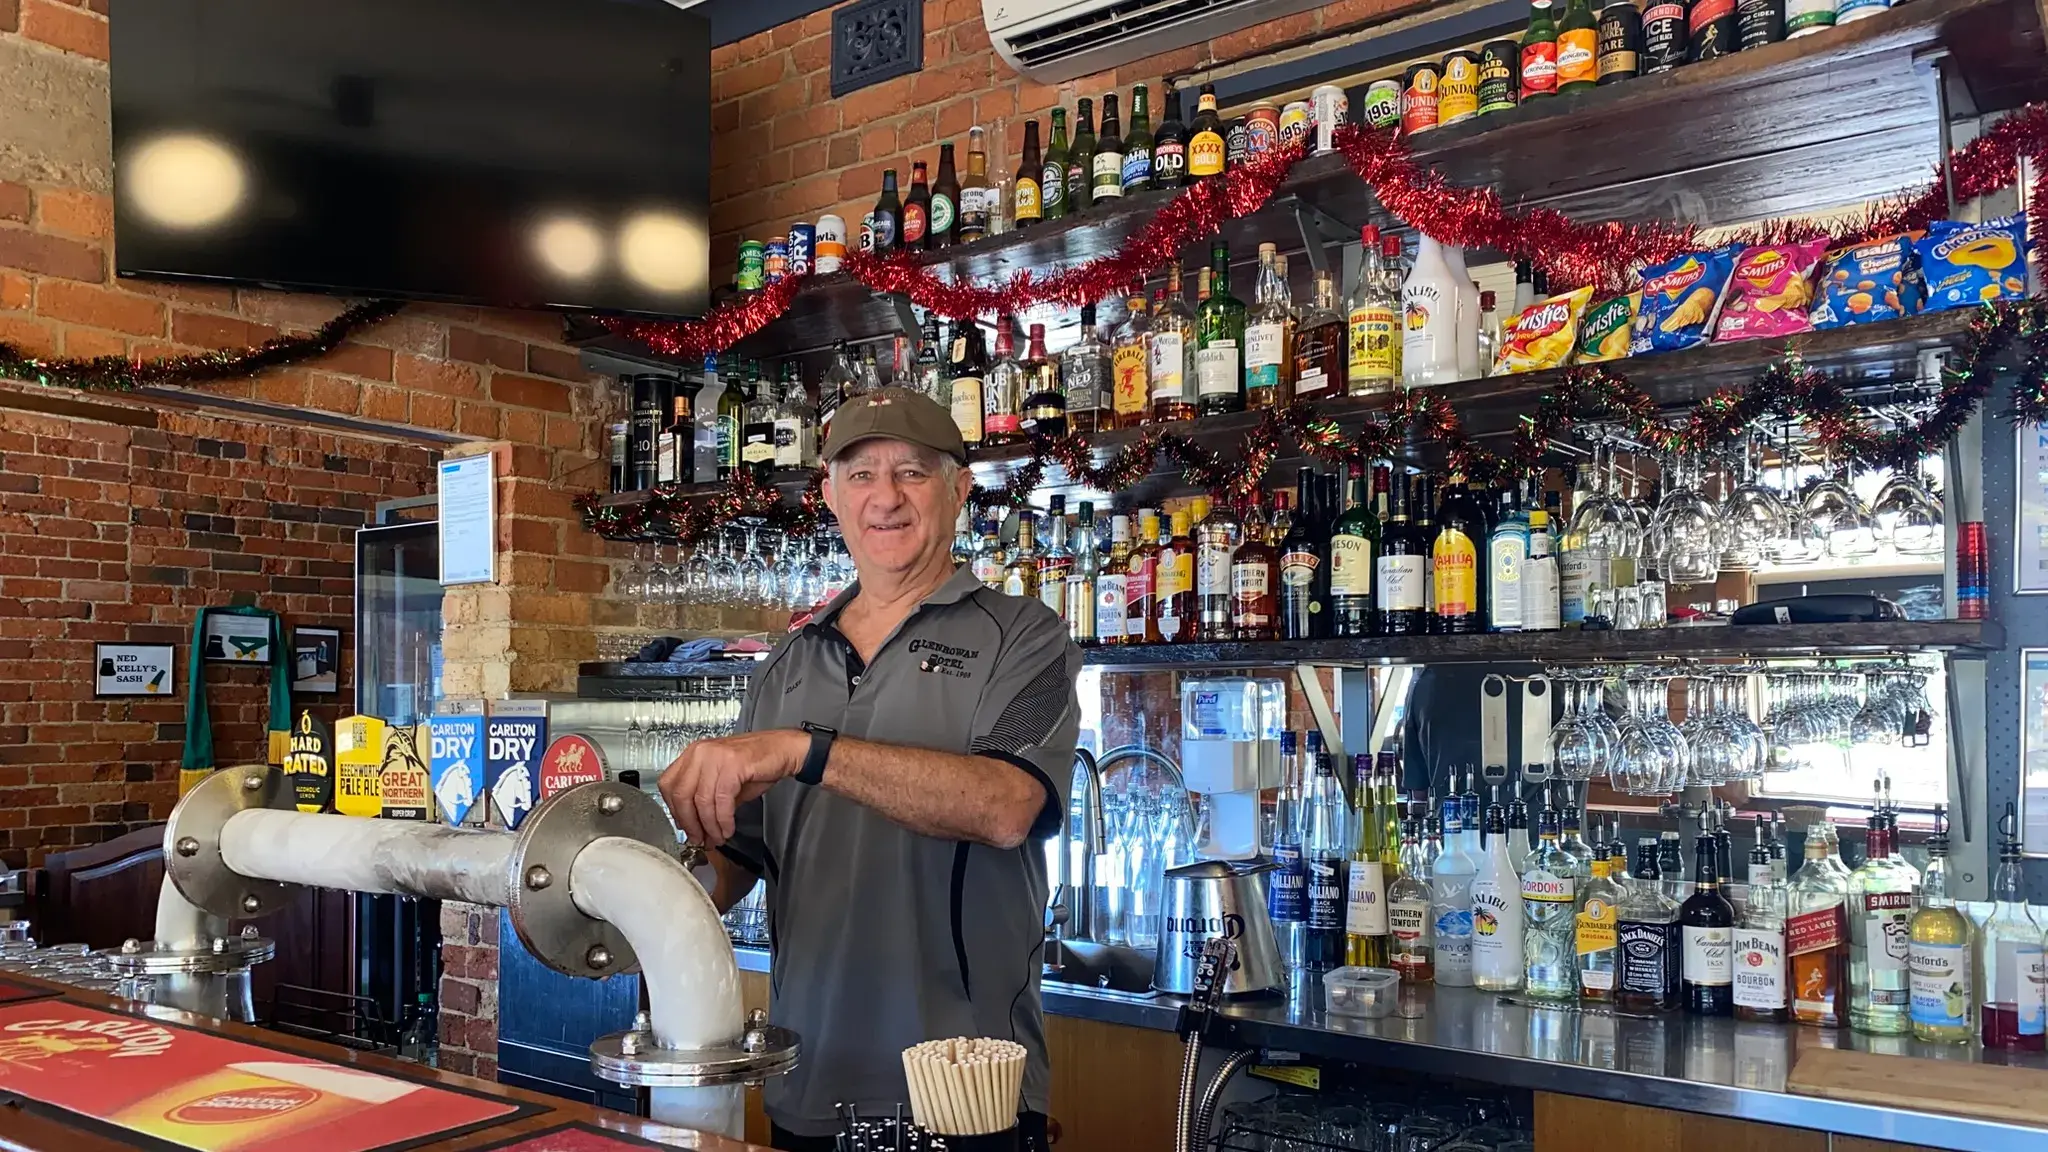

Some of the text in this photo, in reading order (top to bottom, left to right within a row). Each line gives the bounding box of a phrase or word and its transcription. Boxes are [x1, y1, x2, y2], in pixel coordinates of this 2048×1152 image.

[1753, 10, 1775, 18] CIDER
[1647, 18, 1673, 38] ICE
[1156, 145, 1184, 156] TOOHEYS
[1191, 143, 1221, 156] XXXX
[1123, 148, 1150, 167] HAHN
[1155, 153, 1184, 172] OLD
[1194, 155, 1218, 165] GOLD
[793, 230, 808, 275] DRY
[1402, 285, 1441, 303] MALIBU
[1517, 304, 1570, 331] wisties
[1251, 342, 1260, 353] 12
[1113, 350, 1146, 367] FIREBALL
[1067, 371, 1092, 389] NED
[638, 439, 650, 452] 10
[1331, 539, 1362, 552] MESON
[1038, 568, 1068, 584] APEROL
[1233, 569, 1265, 579] SOUTHERN
[1379, 565, 1413, 575] Canadian
[1107, 580, 1125, 596] BEAM
[908, 638, 980, 660] GLENROWAN
[116, 654, 138, 662] NED
[116, 664, 158, 673] KELLY'S
[116, 675, 143, 683] SASH
[431, 723, 475, 736] CARLTON
[488, 723, 536, 737] CARLTON
[290, 736, 322, 753] HARD
[431, 737, 476, 759] DRY
[488, 737, 537, 761] DRY
[283, 752, 328, 777] RATED
[340, 763, 380, 778] BEECHWORTH
[382, 771, 424, 787] GREAT
[363, 778, 380, 797] ALE
[382, 787, 425, 799] NORTHERN
[1271, 875, 1304, 888] GALLIANO
[1522, 879, 1564, 894] GORDON'S
[1307, 883, 1340, 900] GALLIANO
[1470, 893, 1509, 912] MALIBU
[1389, 909, 1423, 919] SOUTHERN
[1390, 919, 1421, 928] COMFORT
[1576, 919, 1616, 931] BUNDABER
[1788, 919, 1838, 937] RED LABEL
[1580, 933, 1613, 941] ORIGINAL
[1620, 928, 1665, 947] JACK DANIEL'S
[1703, 947, 1725, 959] Club
[1733, 939, 1750, 954] JIM
[1751, 937, 1779, 958] BEAM
[1736, 974, 1775, 987] BOURBON
[4, 1019, 176, 1059] CARLTON
